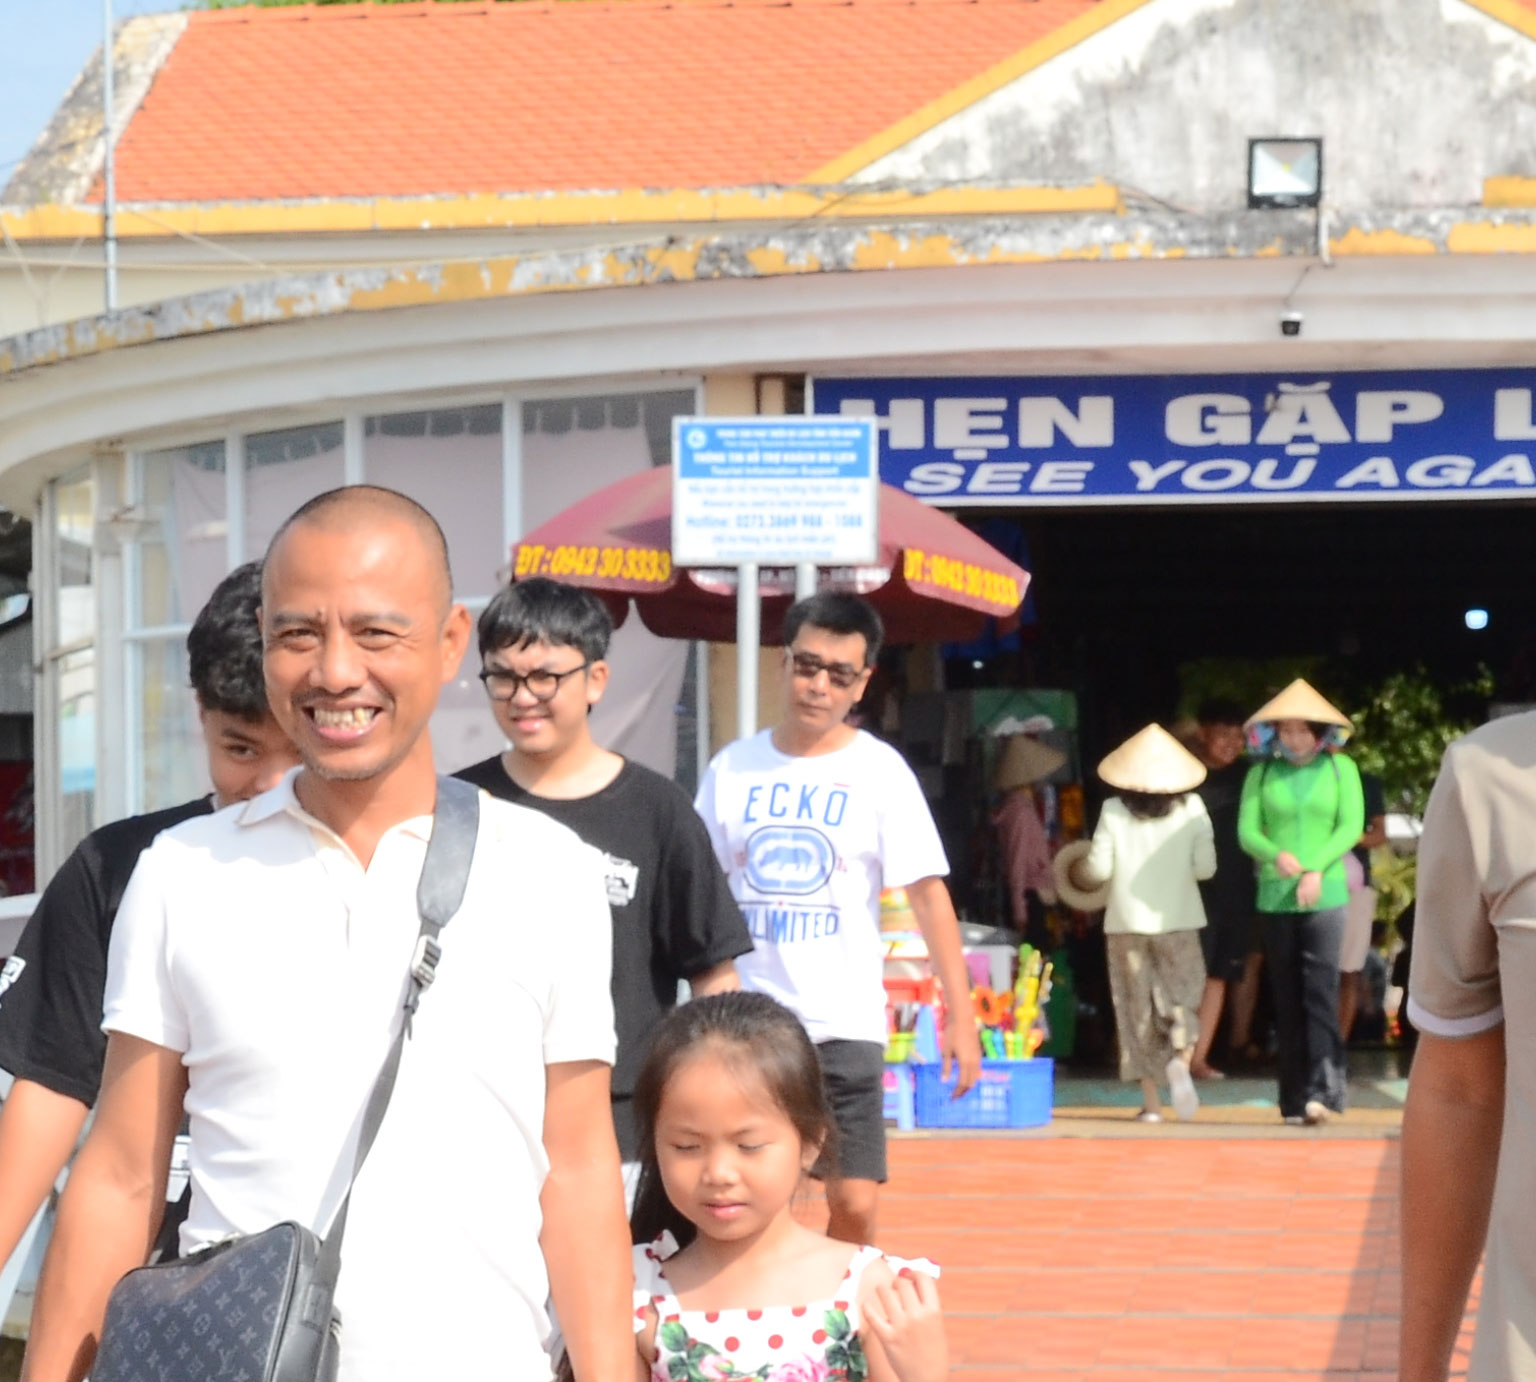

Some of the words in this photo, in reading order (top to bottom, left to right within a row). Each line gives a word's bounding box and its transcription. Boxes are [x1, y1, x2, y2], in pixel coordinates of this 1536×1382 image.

[840, 396, 1114, 461] HẸN
[1165, 381, 1444, 456] GẶP
[903, 461, 1095, 494] SEE
[1128, 457, 1317, 491] YOU
